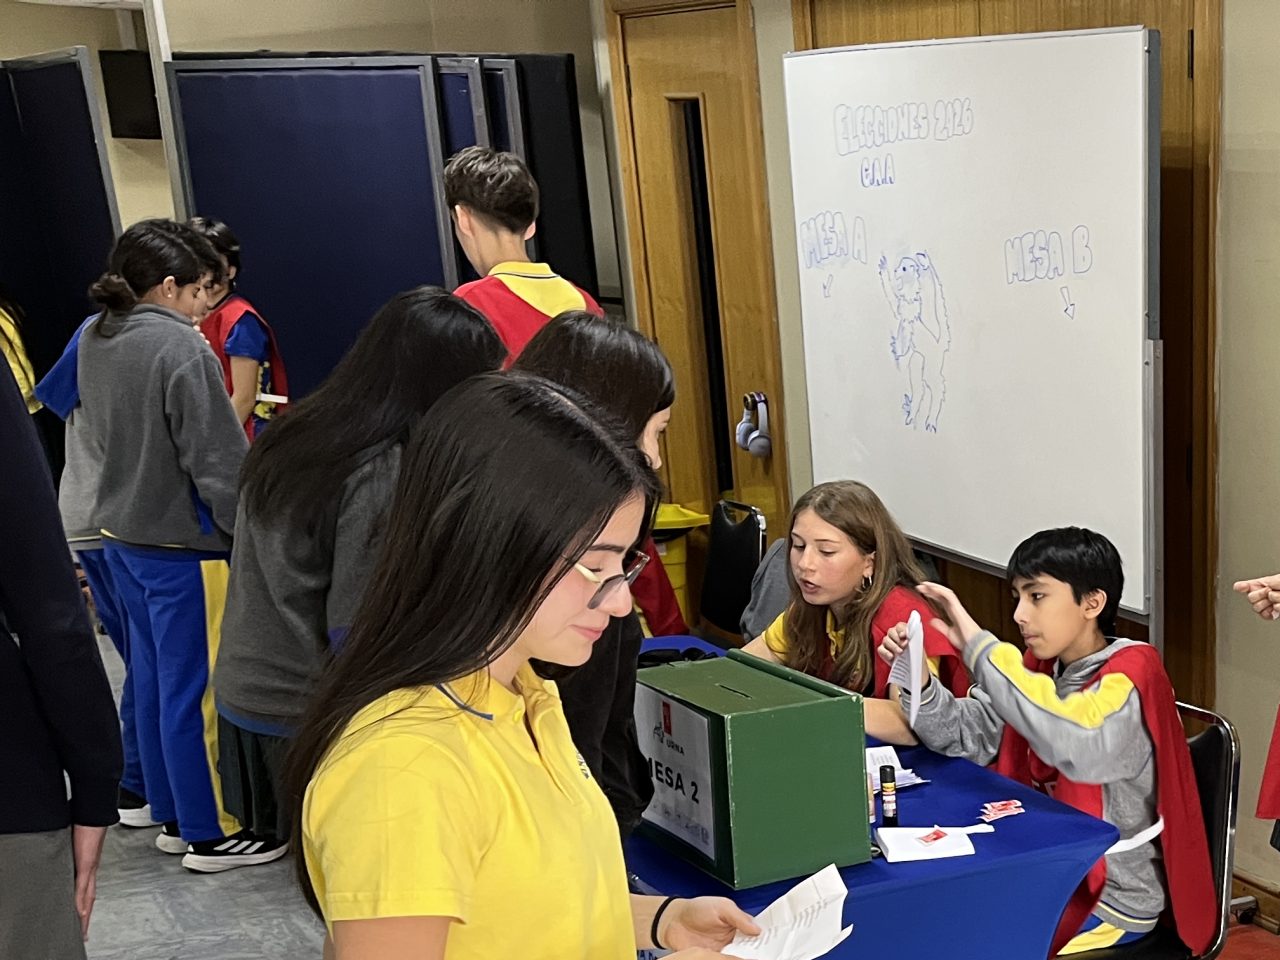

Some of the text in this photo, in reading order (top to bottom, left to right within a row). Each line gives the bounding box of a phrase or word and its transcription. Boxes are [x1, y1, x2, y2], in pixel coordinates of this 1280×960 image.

[800, 211, 868, 269] MESA A
[1004, 225, 1093, 285] MESA B
[691, 781, 699, 805] 2
